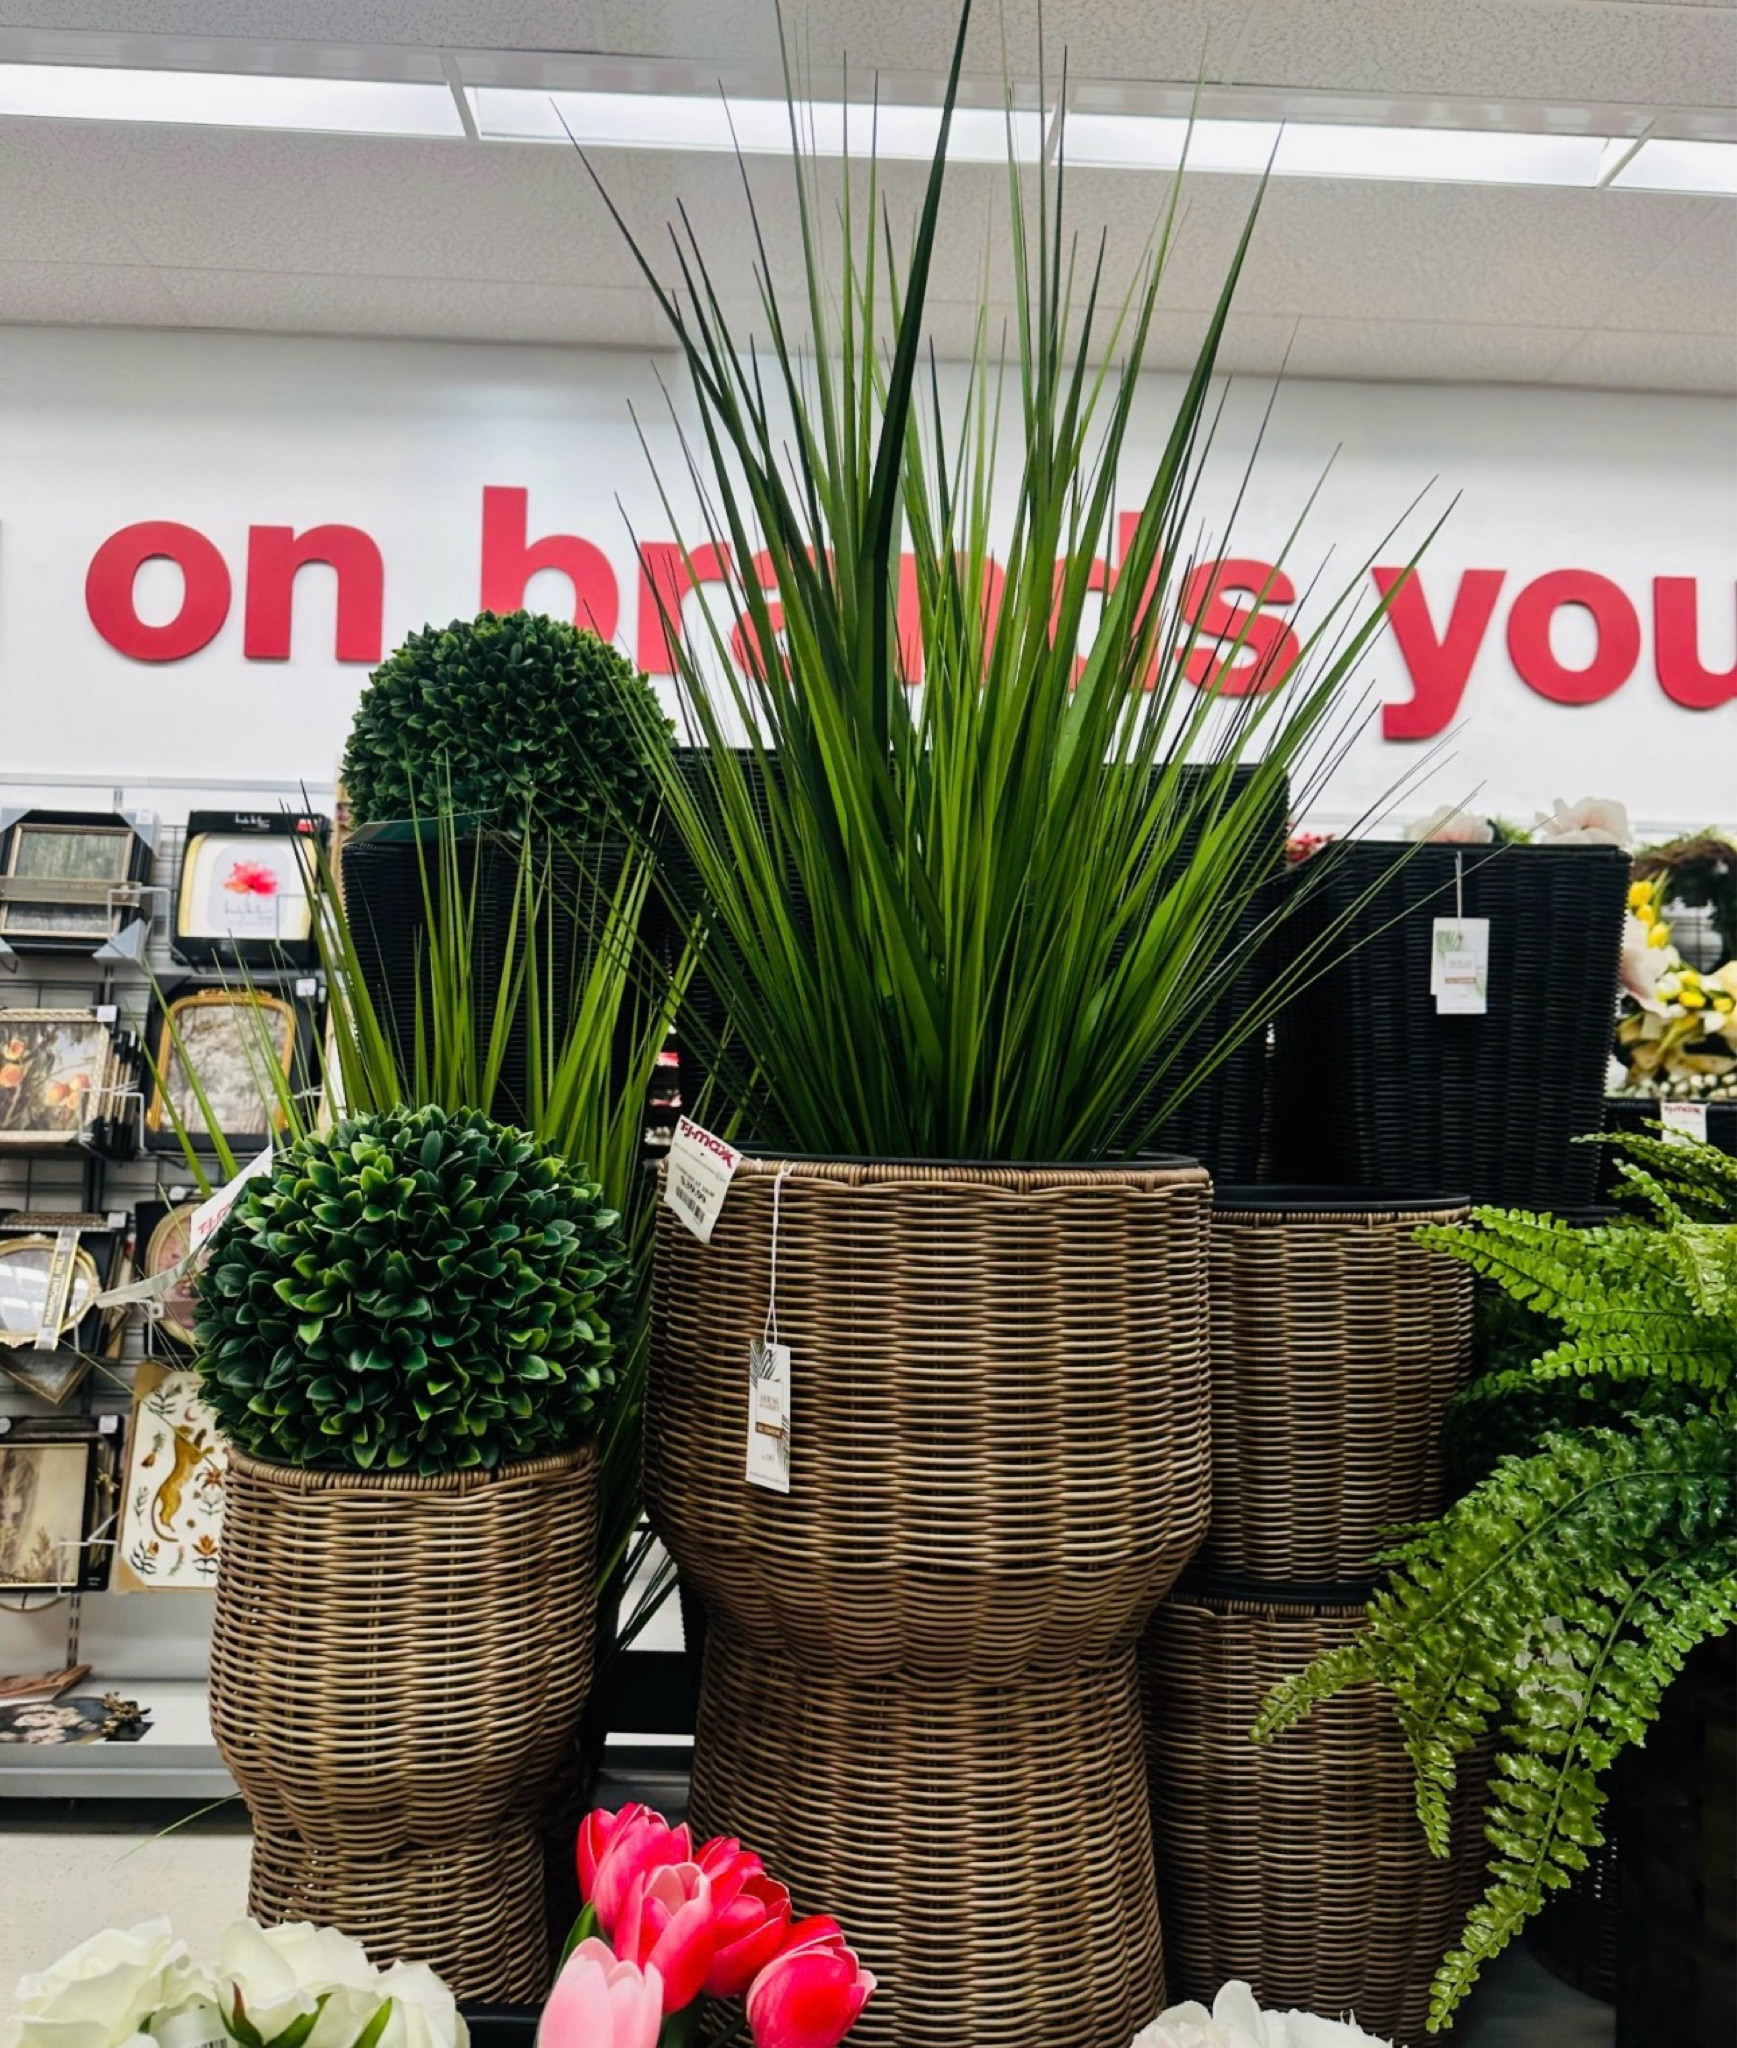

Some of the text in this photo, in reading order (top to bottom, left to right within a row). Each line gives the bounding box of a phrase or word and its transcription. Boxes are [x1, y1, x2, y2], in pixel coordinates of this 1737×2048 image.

[86, 485, 1737, 742] on brs you
